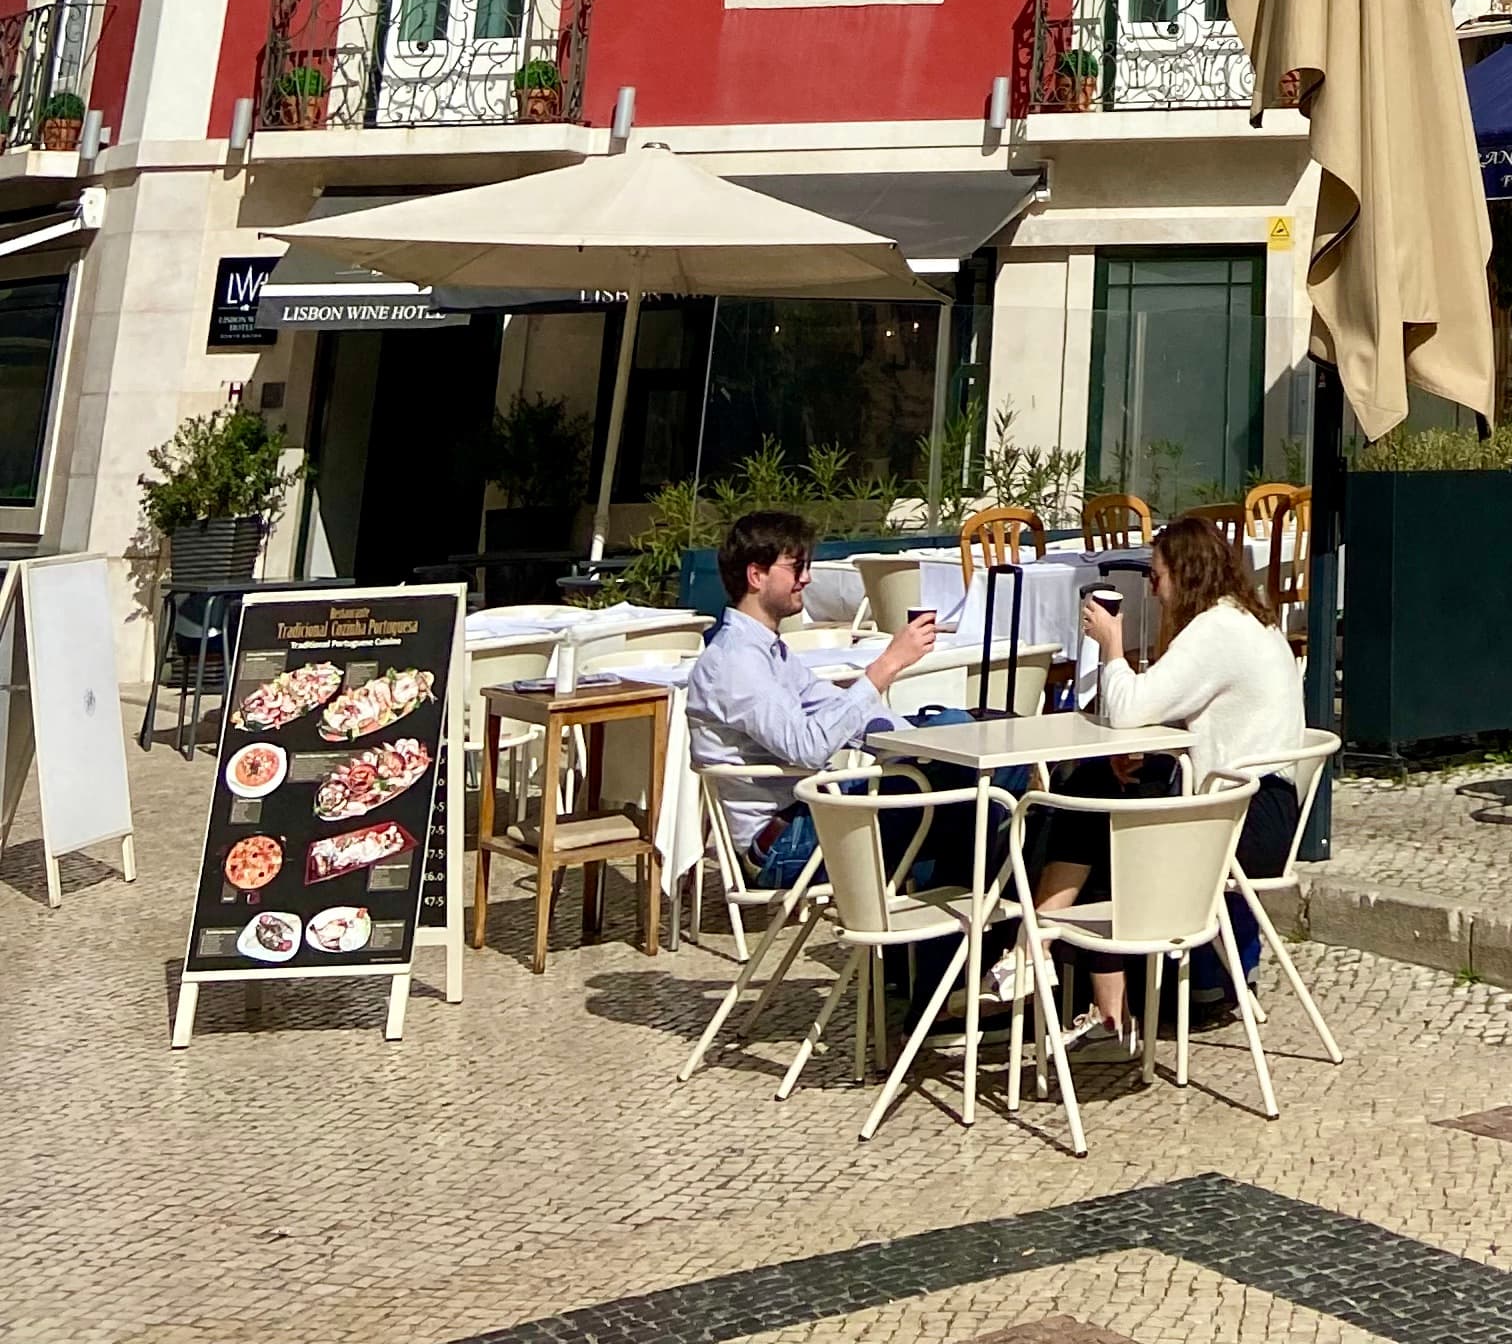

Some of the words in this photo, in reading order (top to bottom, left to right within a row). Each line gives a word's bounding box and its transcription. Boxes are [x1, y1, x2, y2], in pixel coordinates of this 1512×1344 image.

[282, 306, 344, 321] LISBON
[346, 305, 390, 321] WINE
[277, 620, 330, 640] Tradicional
[331, 620, 367, 637] Cozinha
